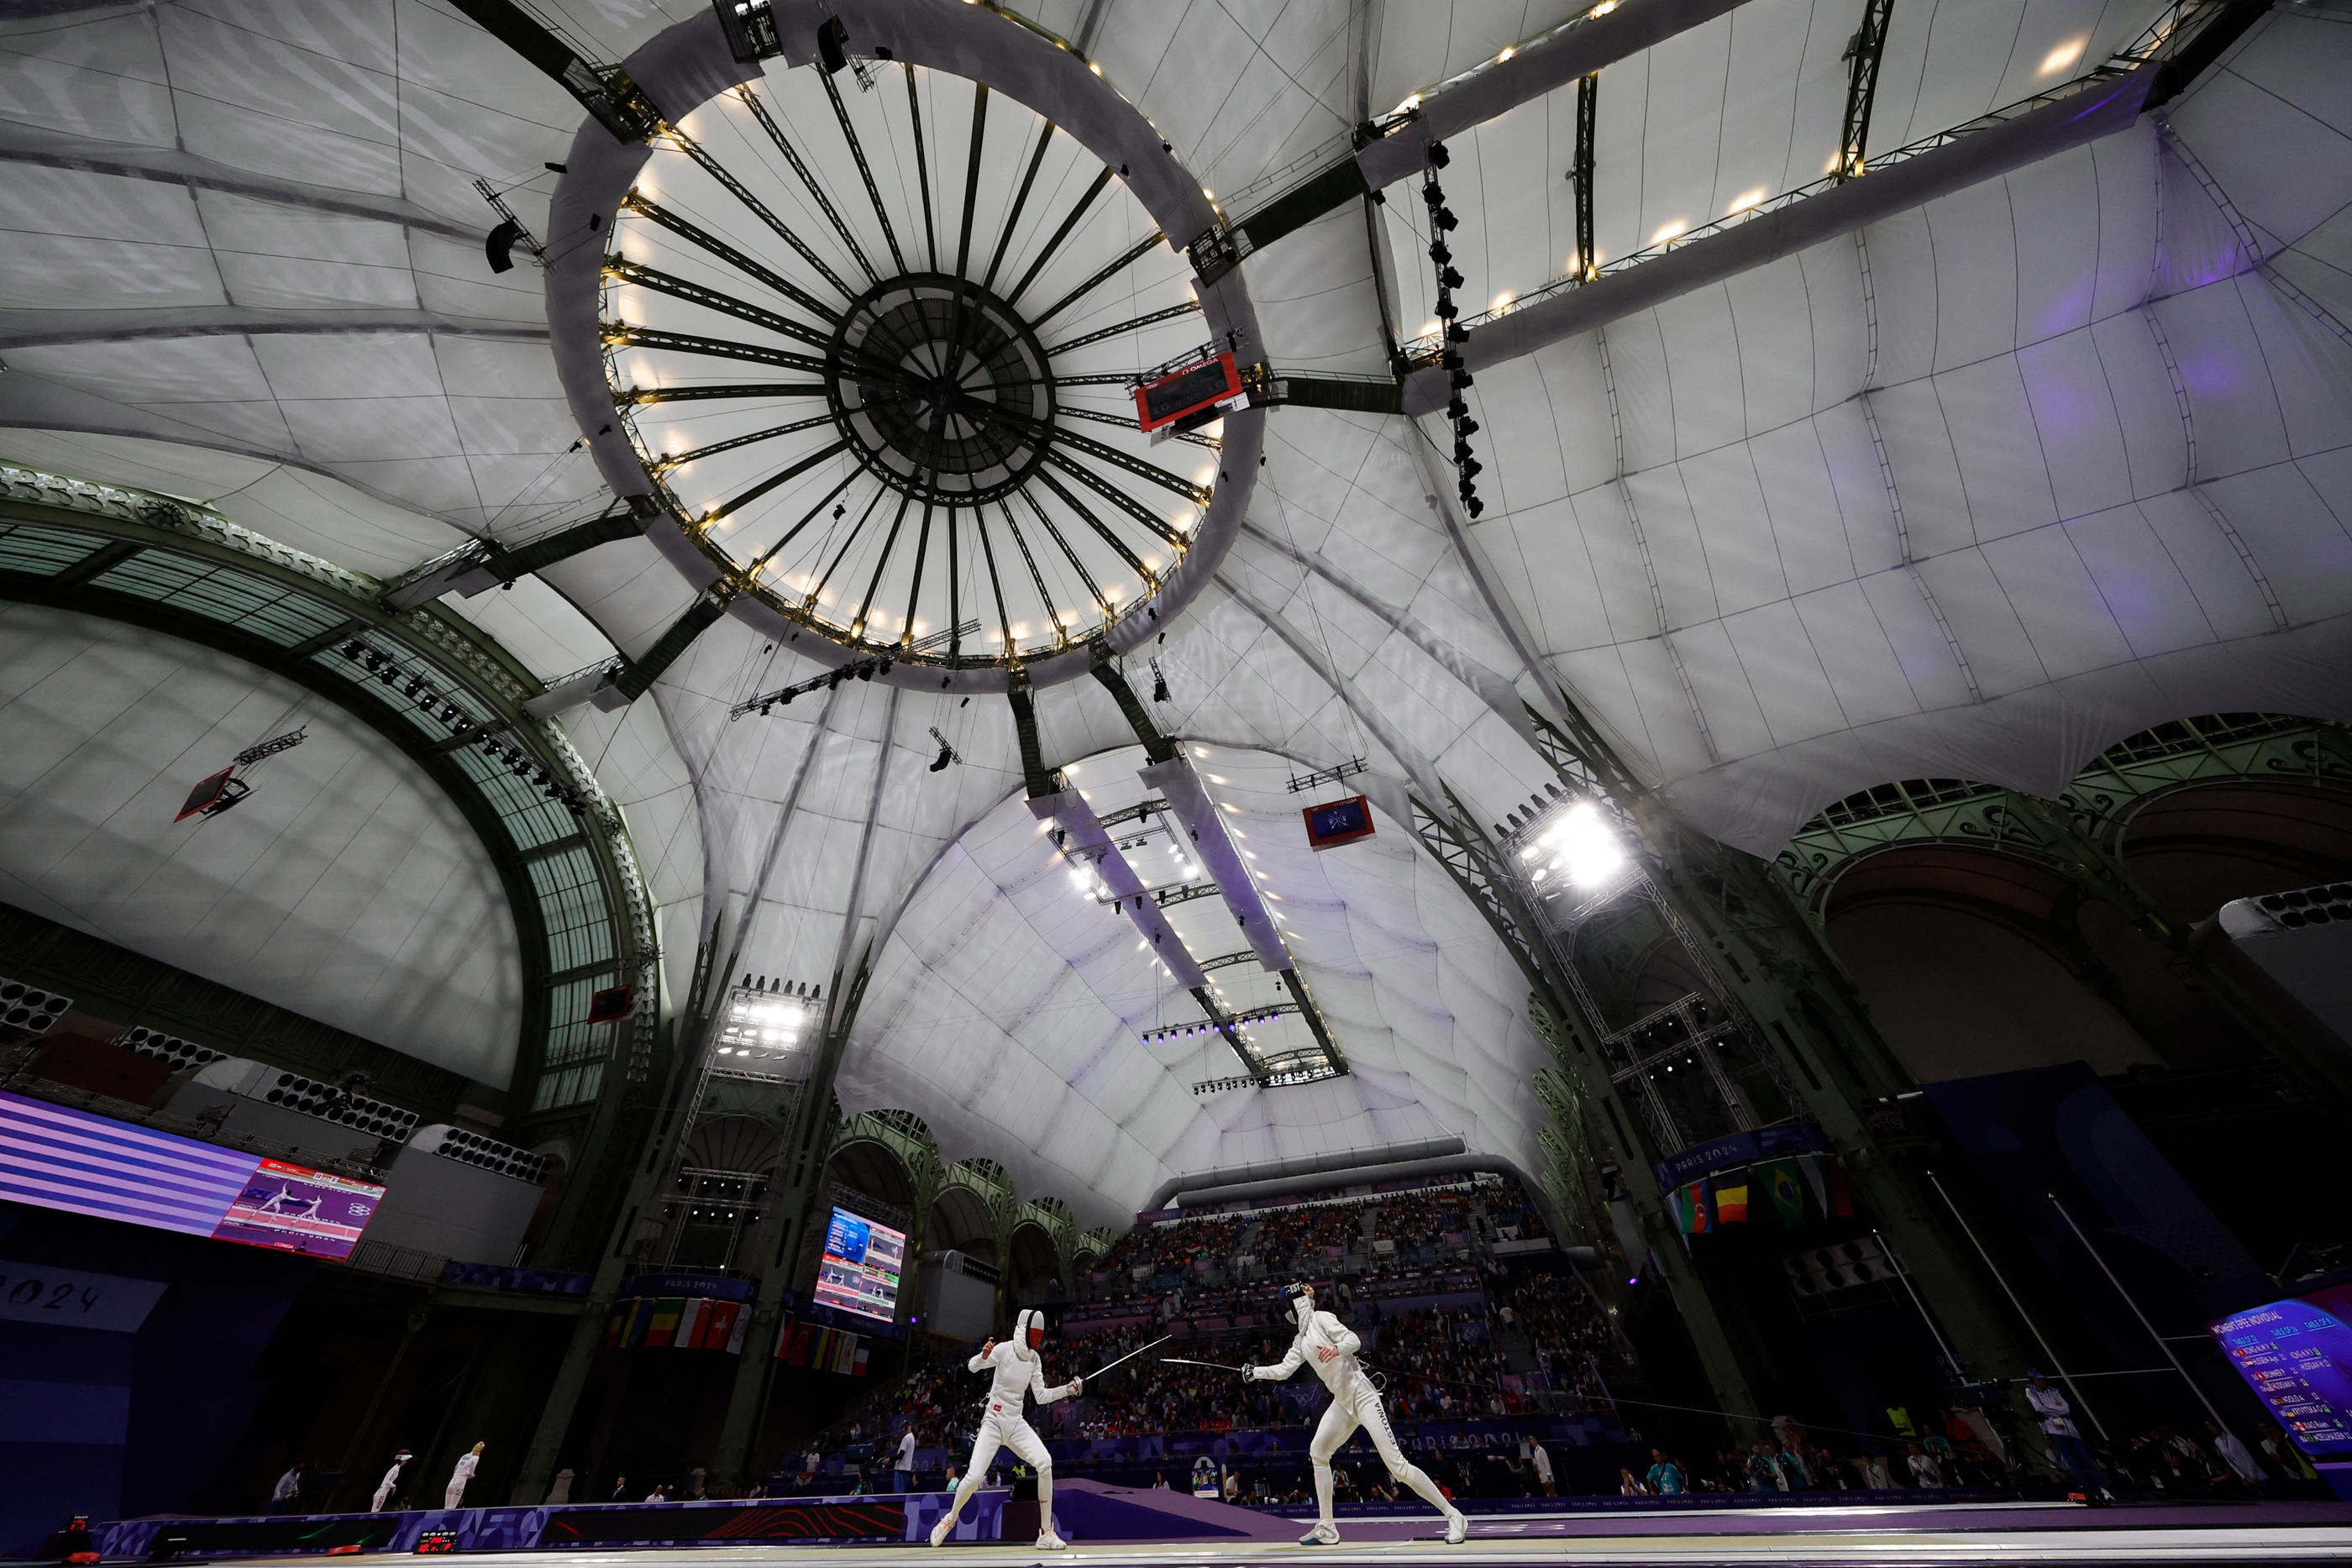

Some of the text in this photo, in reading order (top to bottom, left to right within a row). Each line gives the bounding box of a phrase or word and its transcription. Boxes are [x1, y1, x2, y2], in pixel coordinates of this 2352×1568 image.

[1189, 358, 1219, 372] OMEGA
[1677, 1144, 1738, 1172] PARIS 2024
[664, 1280, 718, 1290] PARIS 2024
[2212, 1322, 2240, 1334] WOMEN'S
[2249, 1310, 2284, 1324] INDIVIDUAL
[1374, 1402, 1396, 1445] ESTONIA
